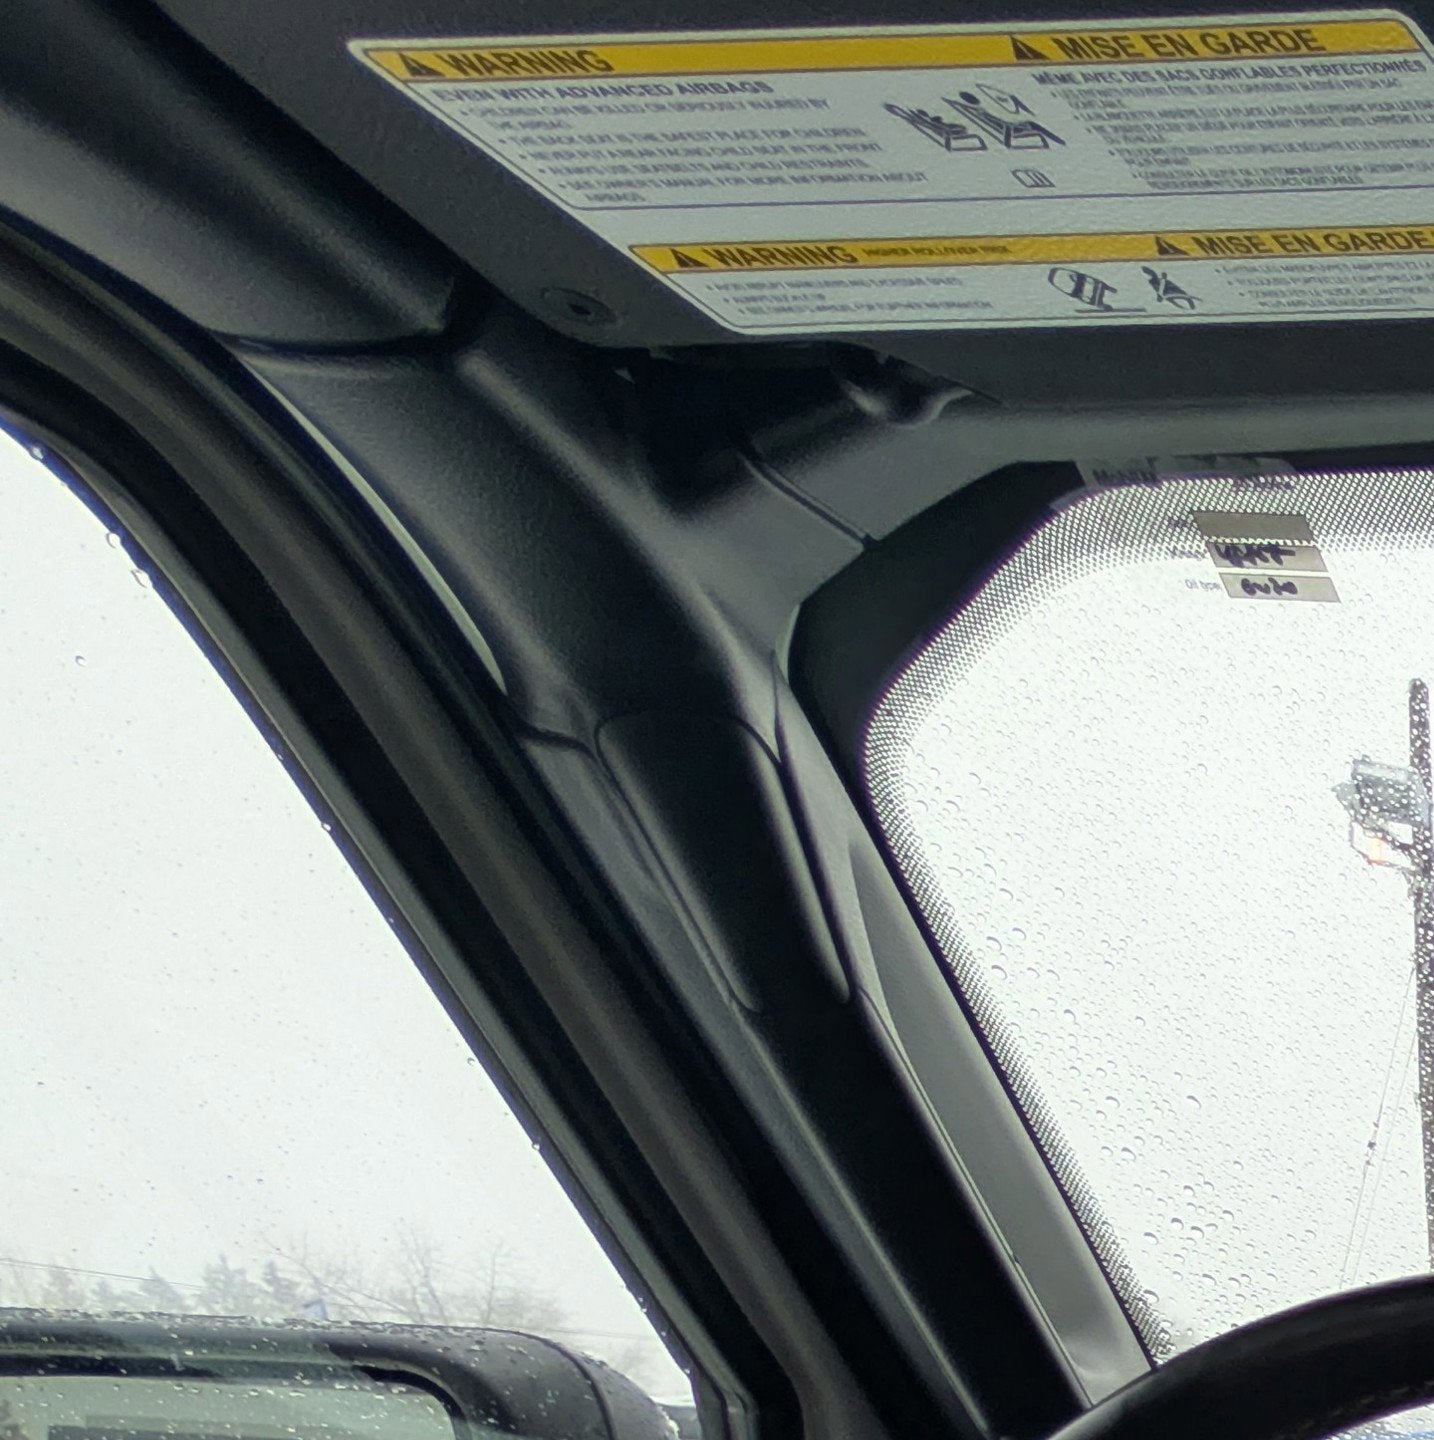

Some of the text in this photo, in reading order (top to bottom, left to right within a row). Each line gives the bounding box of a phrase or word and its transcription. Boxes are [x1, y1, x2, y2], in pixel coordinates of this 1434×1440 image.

[1049, 29, 1329, 59] MISE EN GARDE
[434, 49, 619, 76] WARNING
[1074, 70, 1124, 83] AVEC
[1118, 69, 1159, 82] DES
[430, 81, 777, 102] EVEN WITH ADVANCED AIRBAGS
[1189, 235, 1275, 255] MISE
[1269, 234, 1324, 252] EN
[700, 245, 862, 266] WARNING
